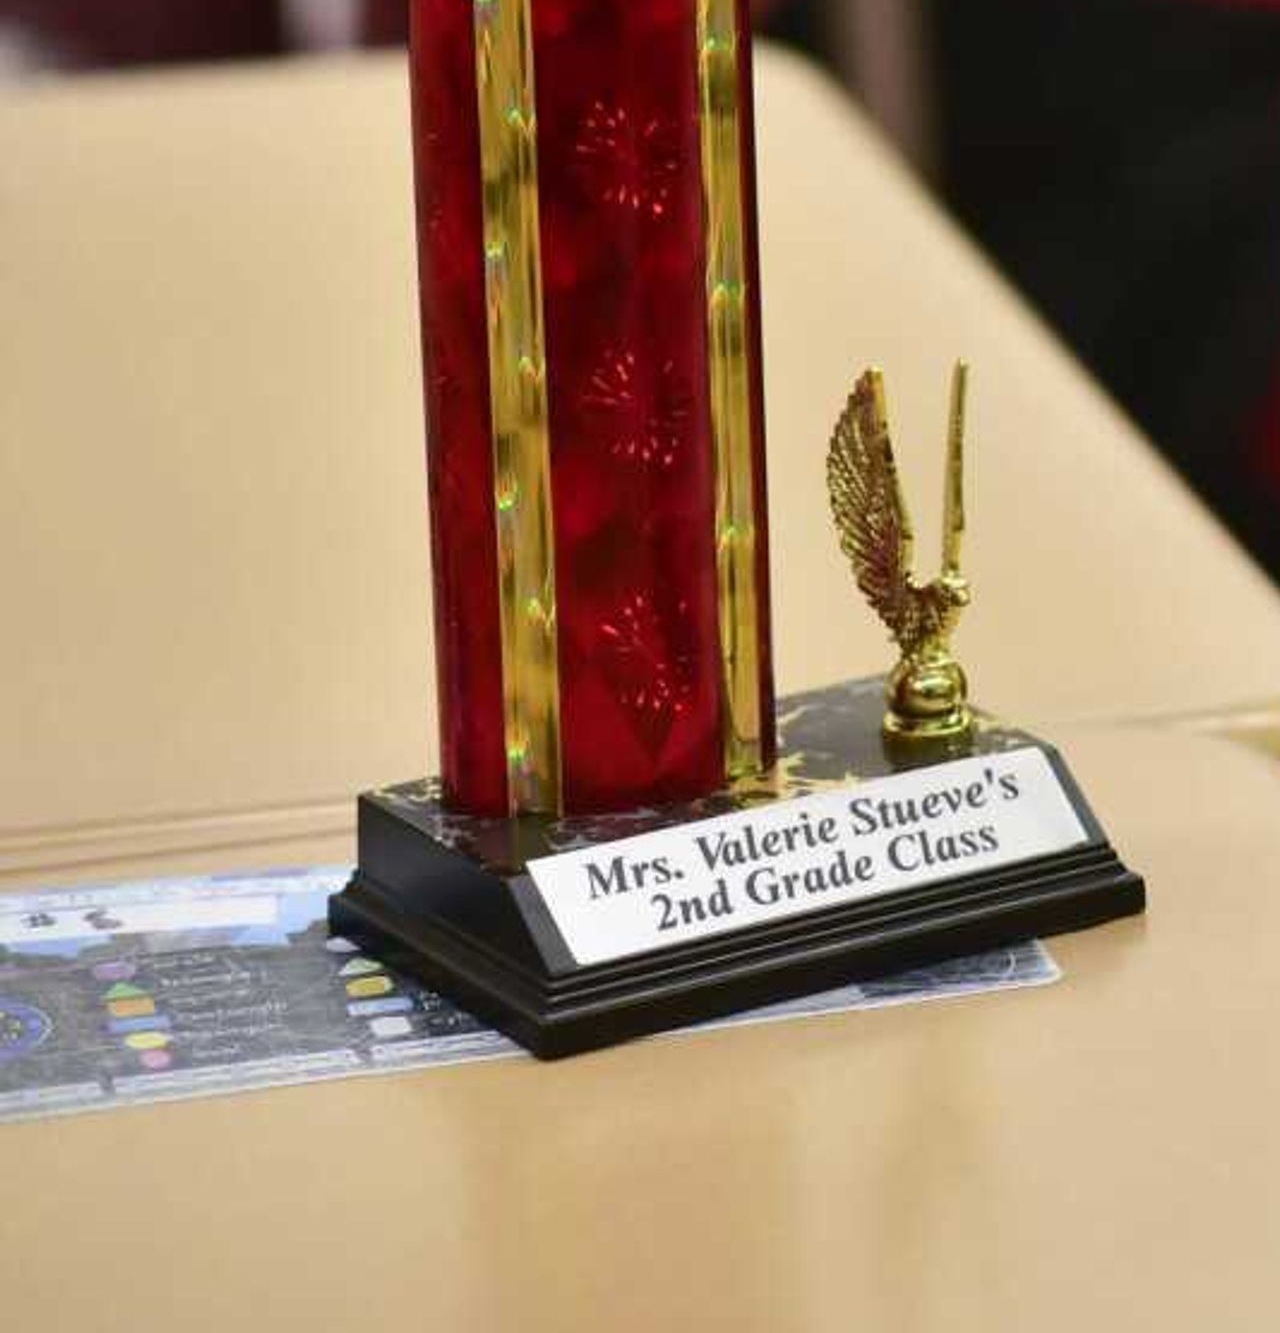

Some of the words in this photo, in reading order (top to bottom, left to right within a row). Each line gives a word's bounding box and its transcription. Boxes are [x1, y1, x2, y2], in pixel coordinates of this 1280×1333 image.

[586, 859, 685, 900] Mrs.
[695, 814, 840, 868] Valerie
[848, 769, 1020, 835] Stueve's
[651, 881, 734, 931] 2nd
[744, 850, 876, 906] Grade
[886, 820, 1000, 872] Class
